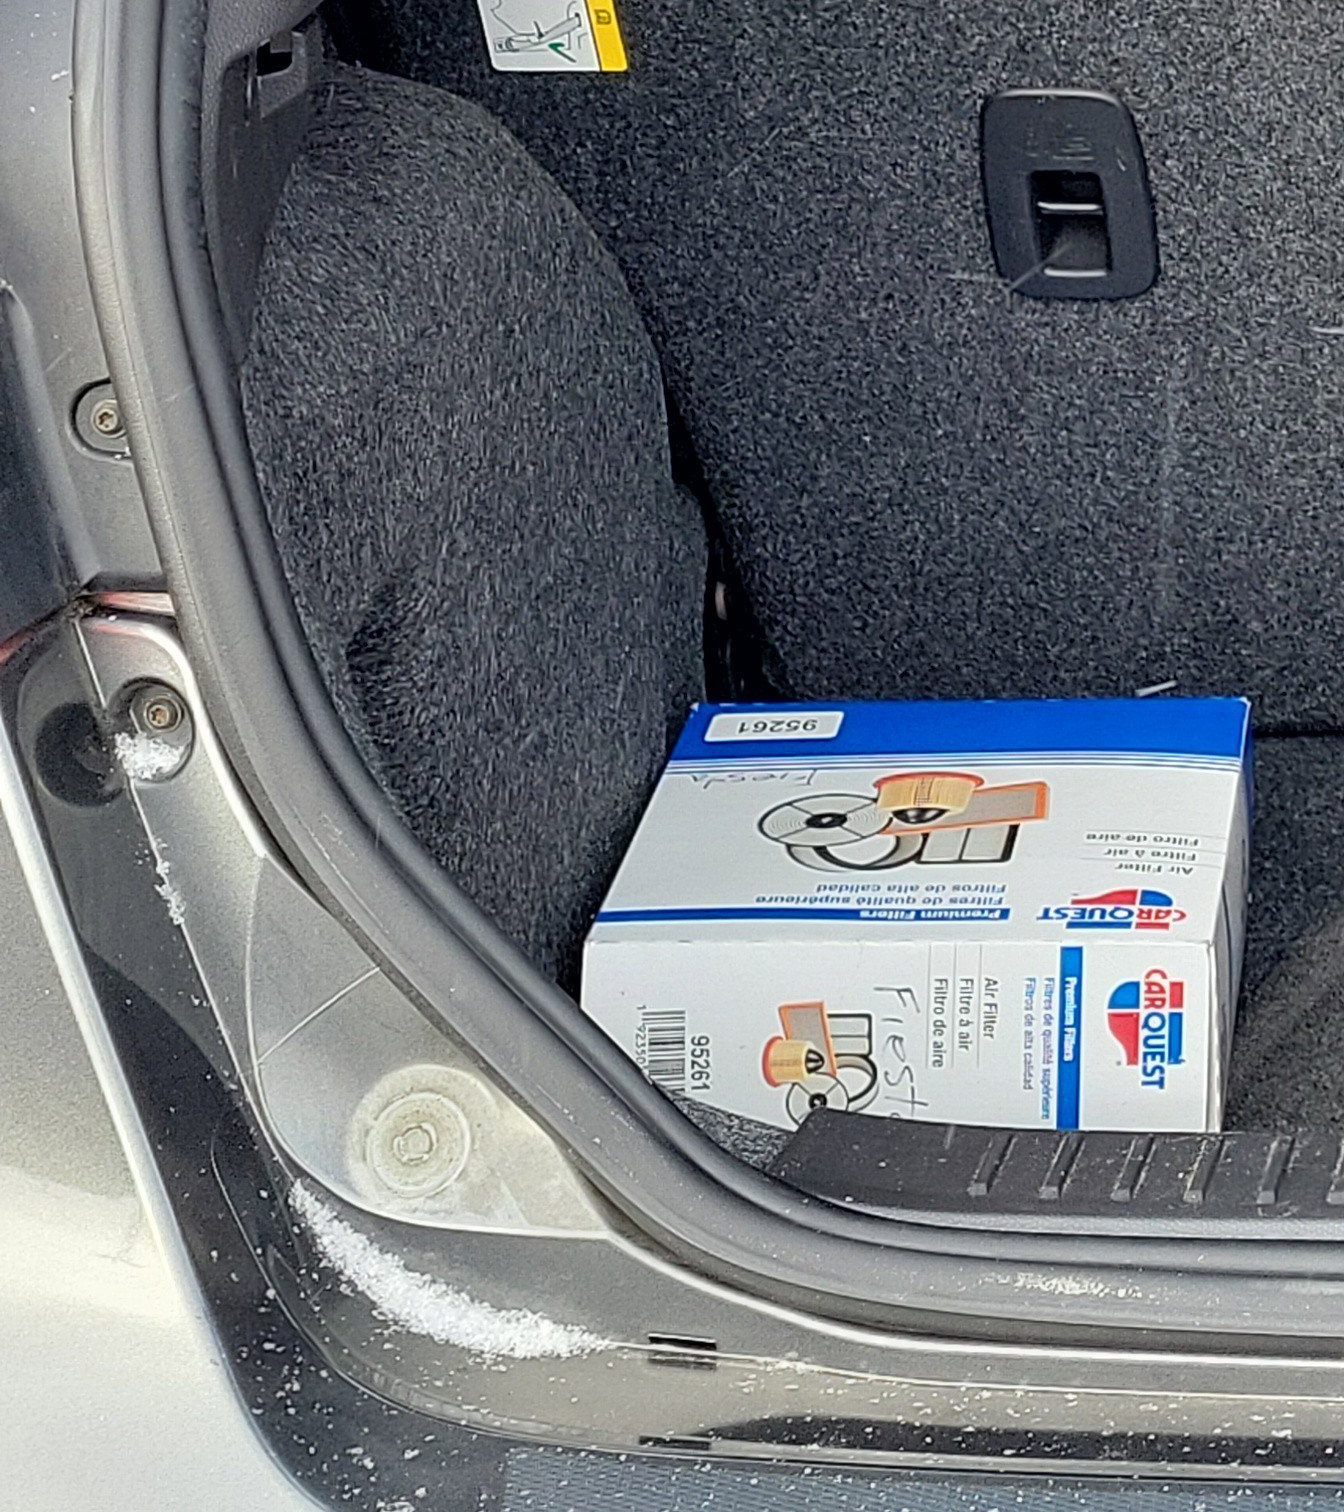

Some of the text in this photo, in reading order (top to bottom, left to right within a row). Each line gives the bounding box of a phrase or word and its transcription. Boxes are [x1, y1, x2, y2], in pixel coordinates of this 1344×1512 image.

[738, 719, 818, 734] 95261
[1152, 835, 1199, 847] Filtro
[1103, 849, 1128, 858] air
[1115, 863, 1194, 875] Air Filter
[815, 883, 1007, 894] Filtros de alta calidad
[922, 897, 943, 906] de
[948, 896, 1004, 906] Filtres
[858, 909, 1002, 920] Premium Filters
[1036, 906, 1187, 922] CARQUEST
[959, 978, 974, 1014] Filtre
[1043, 977, 1055, 1011] Filtres
[982, 977, 998, 1040] Air Filter
[932, 978, 948, 1068] Filtro de aire
[1043, 1013, 1054, 1026] de
[1063, 976, 1078, 1062] Premium Filters
[1022, 977, 1036, 1091] Filtros de alta calidad
[1141, 969, 1168, 1090] CARQUEST
[958, 1032, 973, 1051] air
[690, 1035, 711, 1091] 95261
